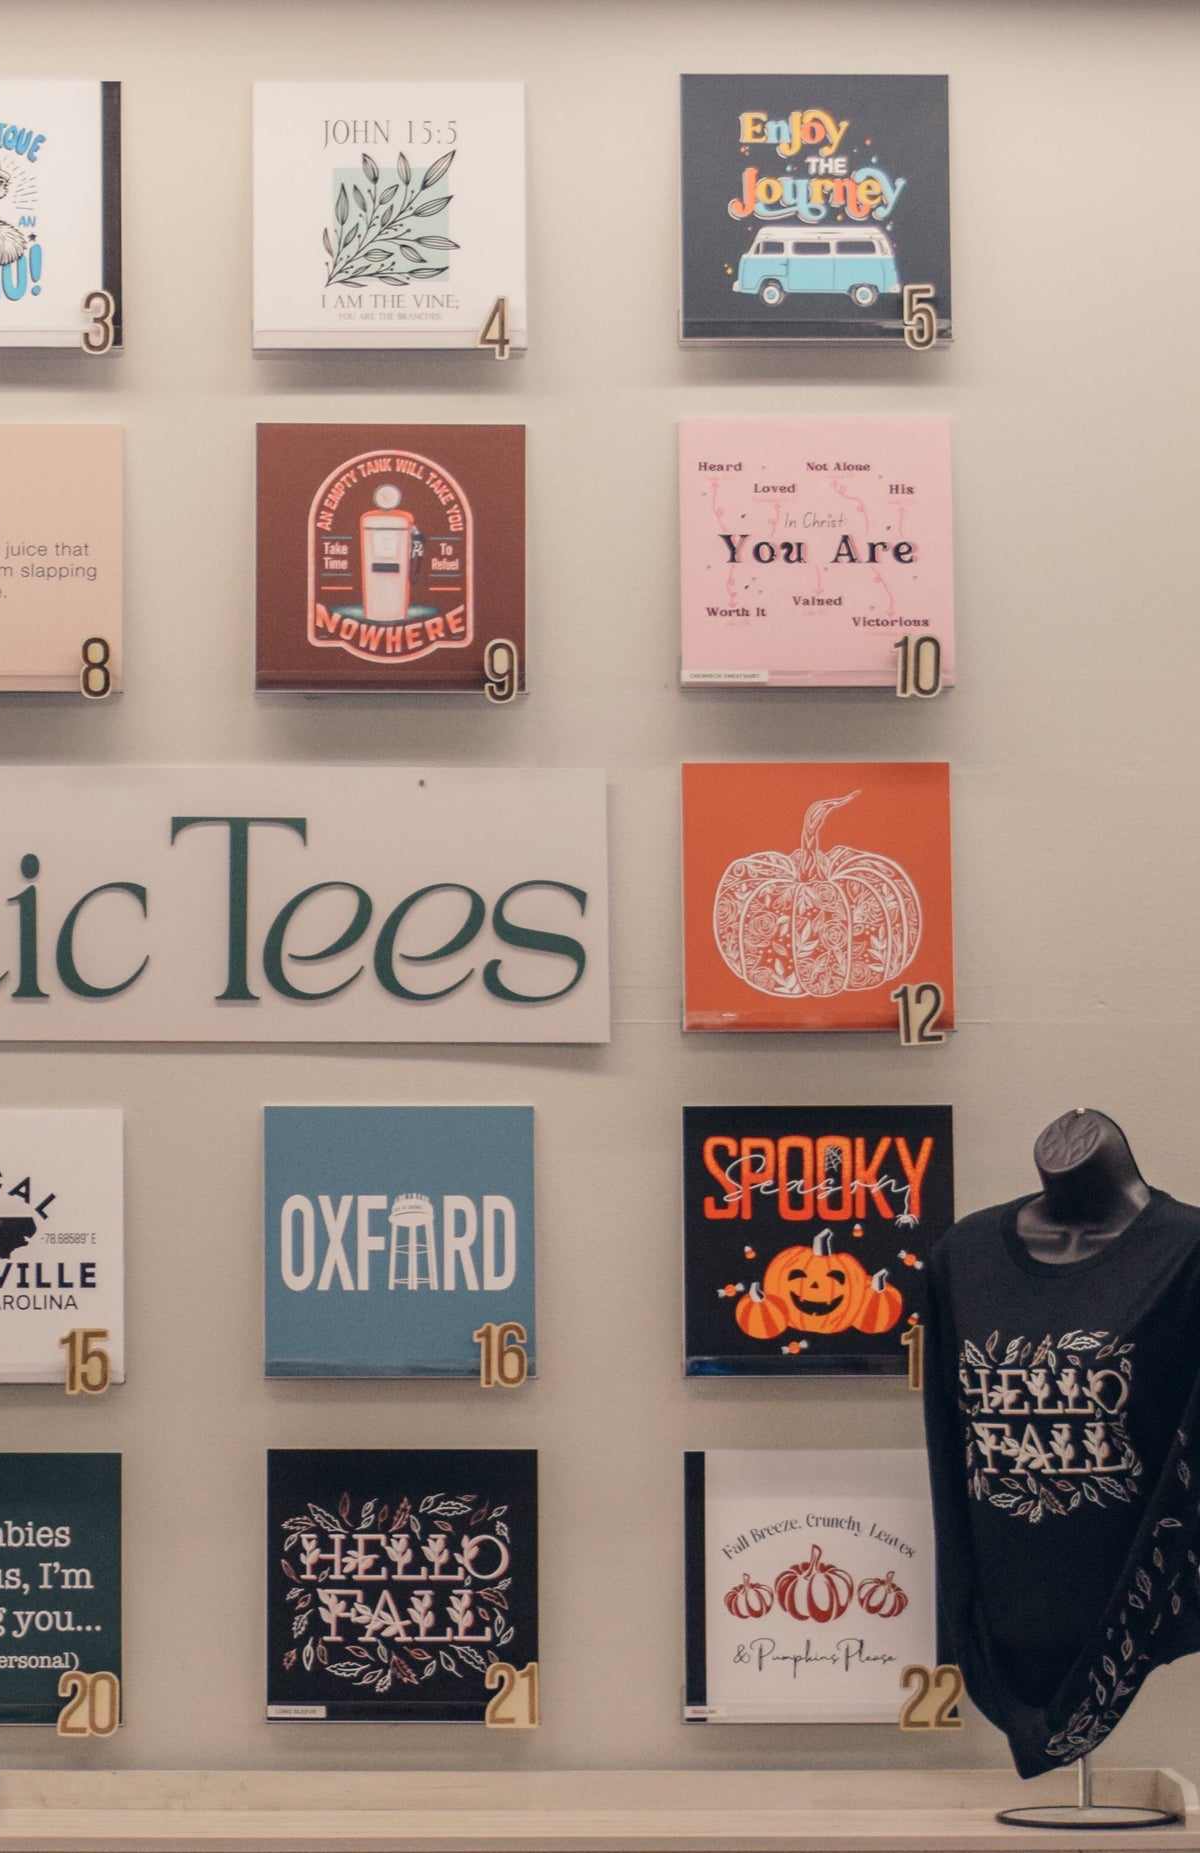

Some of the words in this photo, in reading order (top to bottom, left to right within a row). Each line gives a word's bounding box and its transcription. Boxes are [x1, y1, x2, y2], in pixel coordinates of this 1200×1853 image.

[323, 120, 390, 149] JOHN
[407, 121, 458, 144] 15:5
[806, 157, 847, 175] THE
[728, 167, 906, 223] Journey
[18, 216, 35, 227] AN
[321, 295, 325, 308] I
[333, 295, 362, 308] AM
[370, 295, 405, 309] THE
[412, 295, 459, 310] VINE;
[903, 284, 936, 350] 5
[81, 290, 114, 354] 3
[477, 295, 511, 359] 4
[357, 458, 392, 477] TANK
[396, 459, 425, 480] WILL
[698, 462, 742, 471] Heard
[806, 462, 828, 471] Not
[834, 462, 871, 471] Alone
[324, 470, 358, 510] EMPTY
[425, 472, 454, 505] TAKE
[754, 484, 796, 493] Loved
[889, 485, 914, 494] His
[317, 514, 333, 531] AN
[446, 504, 463, 532] YOU
[784, 513, 797, 528] In
[803, 512, 844, 528] Christ
[5, 543, 47, 559] juice
[55, 543, 89, 556] that
[323, 543, 348, 555] Take
[323, 557, 348, 570] Time
[440, 543, 452, 555] To
[718, 534, 807, 564] You
[831, 535, 915, 564] Are
[20, 564, 97, 581] slapping
[431, 559, 458, 571] Refuel
[707, 607, 750, 617] Worth
[756, 608, 767, 617] It
[793, 597, 842, 606] Valued
[315, 603, 465, 653] NOWHERE
[852, 617, 929, 627] Victorious
[80, 636, 112, 700] 8
[484, 638, 518, 703] 9
[893, 634, 942, 697] 10
[170, 815, 588, 1004] Tees
[891, 982, 945, 1045] 12
[703, 1135, 934, 1221] SPOOKY
[723, 1154, 911, 1202] Season
[58, 1328, 110, 1394] 15
[473, 1322, 527, 1387] 16
[959, 1369, 1129, 1415] HELLO
[972, 1422, 1128, 1474] FALL
[722, 1535, 749, 1560] Fall
[806, 1513, 862, 1537] Crunchy
[869, 1523, 915, 1558] Leaves
[300, 1534, 510, 1581] HELLO
[39, 1562, 94, 1589] I'm
[12, 1609, 101, 1638] you...
[317, 1589, 491, 1642] FALL
[733, 1644, 750, 1663] &
[750, 1638, 840, 1679] Pumpkins
[837, 1638, 897, 1672] Please
[58, 1671, 119, 1737] 20
[485, 1662, 538, 1728] 21
[900, 1664, 963, 1731] 22
